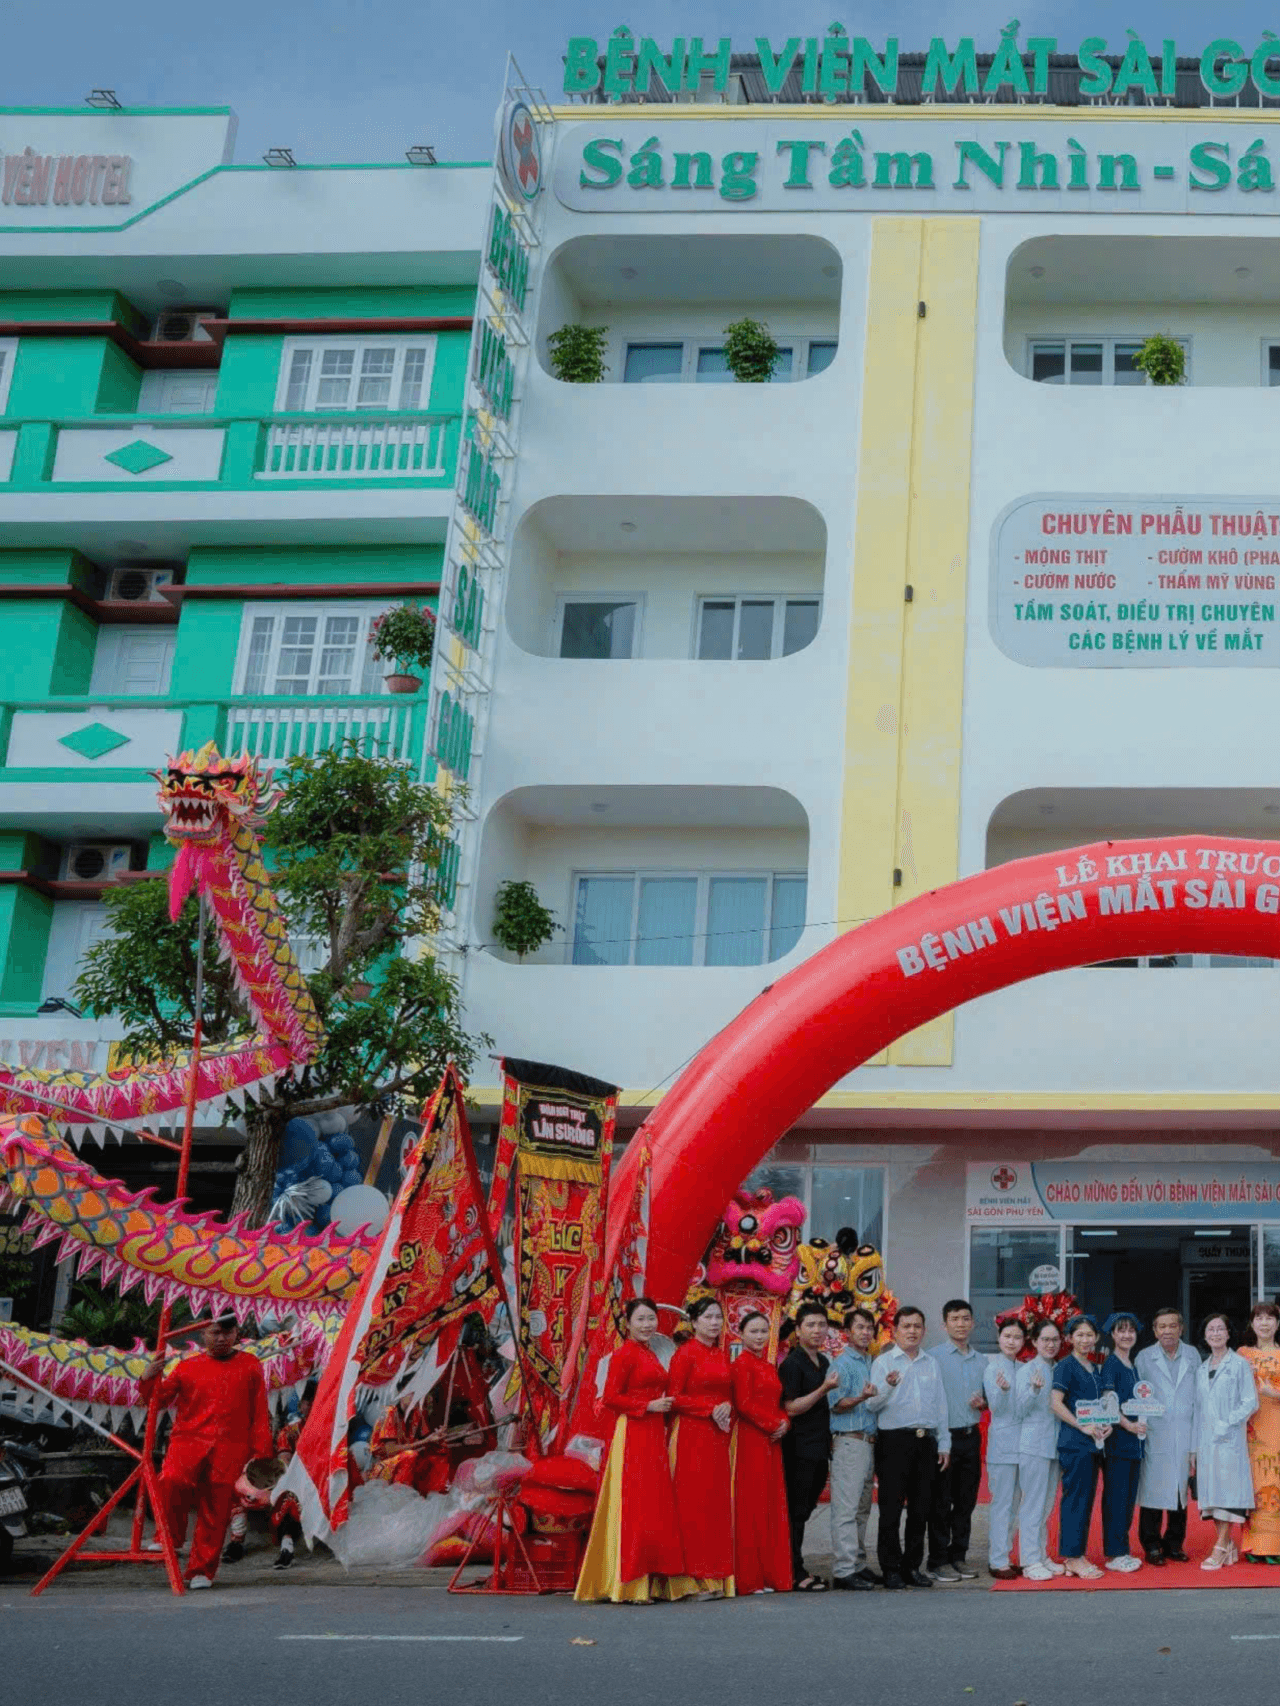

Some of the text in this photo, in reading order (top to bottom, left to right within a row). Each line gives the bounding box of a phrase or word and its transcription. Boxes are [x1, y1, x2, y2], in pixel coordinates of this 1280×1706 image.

[563, 25, 731, 103] BỆNH
[755, 21, 899, 104] VIỆN
[922, 19, 1058, 96] MẮT
[1078, 27, 1177, 98] SÀI
[579, 136, 760, 201] Sáng
[776, 128, 936, 192] Tầm
[953, 137, 1141, 191] Nhìn
[1042, 509, 1133, 535] CHUYÊN
[1141, 506, 1202, 536] PHẪU
[1024, 548, 1071, 569] MỘNG
[1076, 549, 1108, 568] THỊT
[1158, 549, 1203, 566] CƯỜM
[1207, 548, 1238, 566] KHÔ
[1023, 573, 1069, 590] CƯỜM
[1074, 572, 1116, 590] NƯỚC
[1158, 570, 1201, 590] THẨM
[1206, 572, 1230, 590] MỸ
[1234, 572, 1275, 590] VÙNG
[1014, 599, 1054, 621] TẦM
[1060, 600, 1111, 623] SOÁT,
[1117, 598, 1160, 621] ĐIỀU
[1167, 604, 1195, 625] TRỊ
[1201, 601, 1275, 622] CHUYÊN
[1068, 628, 1264, 654] CÁC BỆNH LÝ VỀ MẮT
[1056, 854, 1099, 888] LỄ
[1106, 849, 1188, 878] KHAI
[896, 918, 999, 979] BỆNH
[1000, 889, 1088, 938] VIỆN
[1100, 875, 1177, 916] MẮT
[1185, 873, 1247, 909] SÀI
[1046, 1179, 1080, 1203] CHÀO
[1084, 1179, 1118, 1203] MỪNG
[1121, 1175, 1143, 1203] ĐẾN
[1146, 1178, 1167, 1203] VỚI
[1169, 1178, 1199, 1208] BỆNH
[1201, 1178, 1226, 1208] VIỆN
[1229, 1173, 1253, 1203] MẮT
[1254, 1177, 1272, 1202] SÀI
